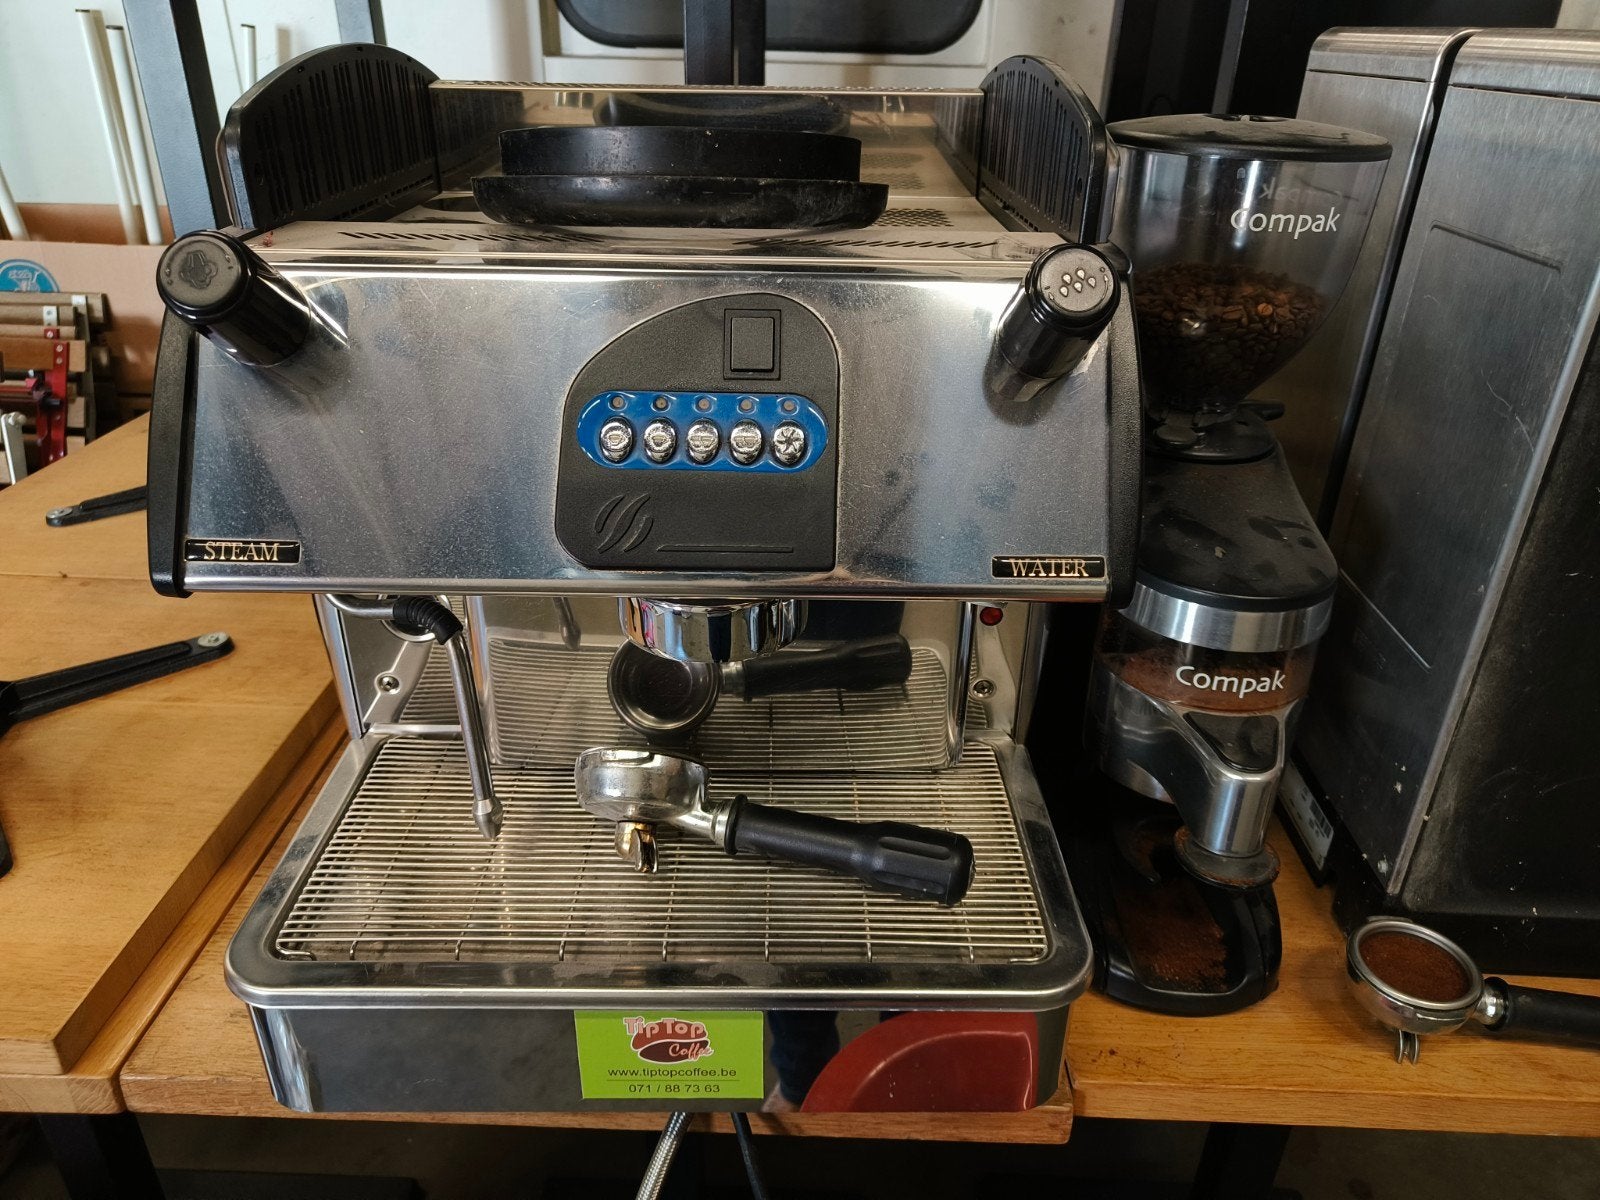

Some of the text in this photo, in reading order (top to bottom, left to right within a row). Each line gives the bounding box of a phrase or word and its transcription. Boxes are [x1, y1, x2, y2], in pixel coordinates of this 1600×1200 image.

[1229, 206, 1341, 240] Compak
[203, 541, 280, 561] STEAM
[1009, 558, 1090, 577] WATER
[1175, 665, 1286, 699] Compak
[623, 1016, 706, 1038] Tip Top
[668, 1042, 713, 1061] Coffee
[607, 1067, 737, 1078] www.tiptopcoffee.be
[628, 1084, 652, 1093] 071
[664, 1084, 681, 1093] 88
[685, 1084, 701, 1093] 73
[704, 1084, 721, 1093] 63
